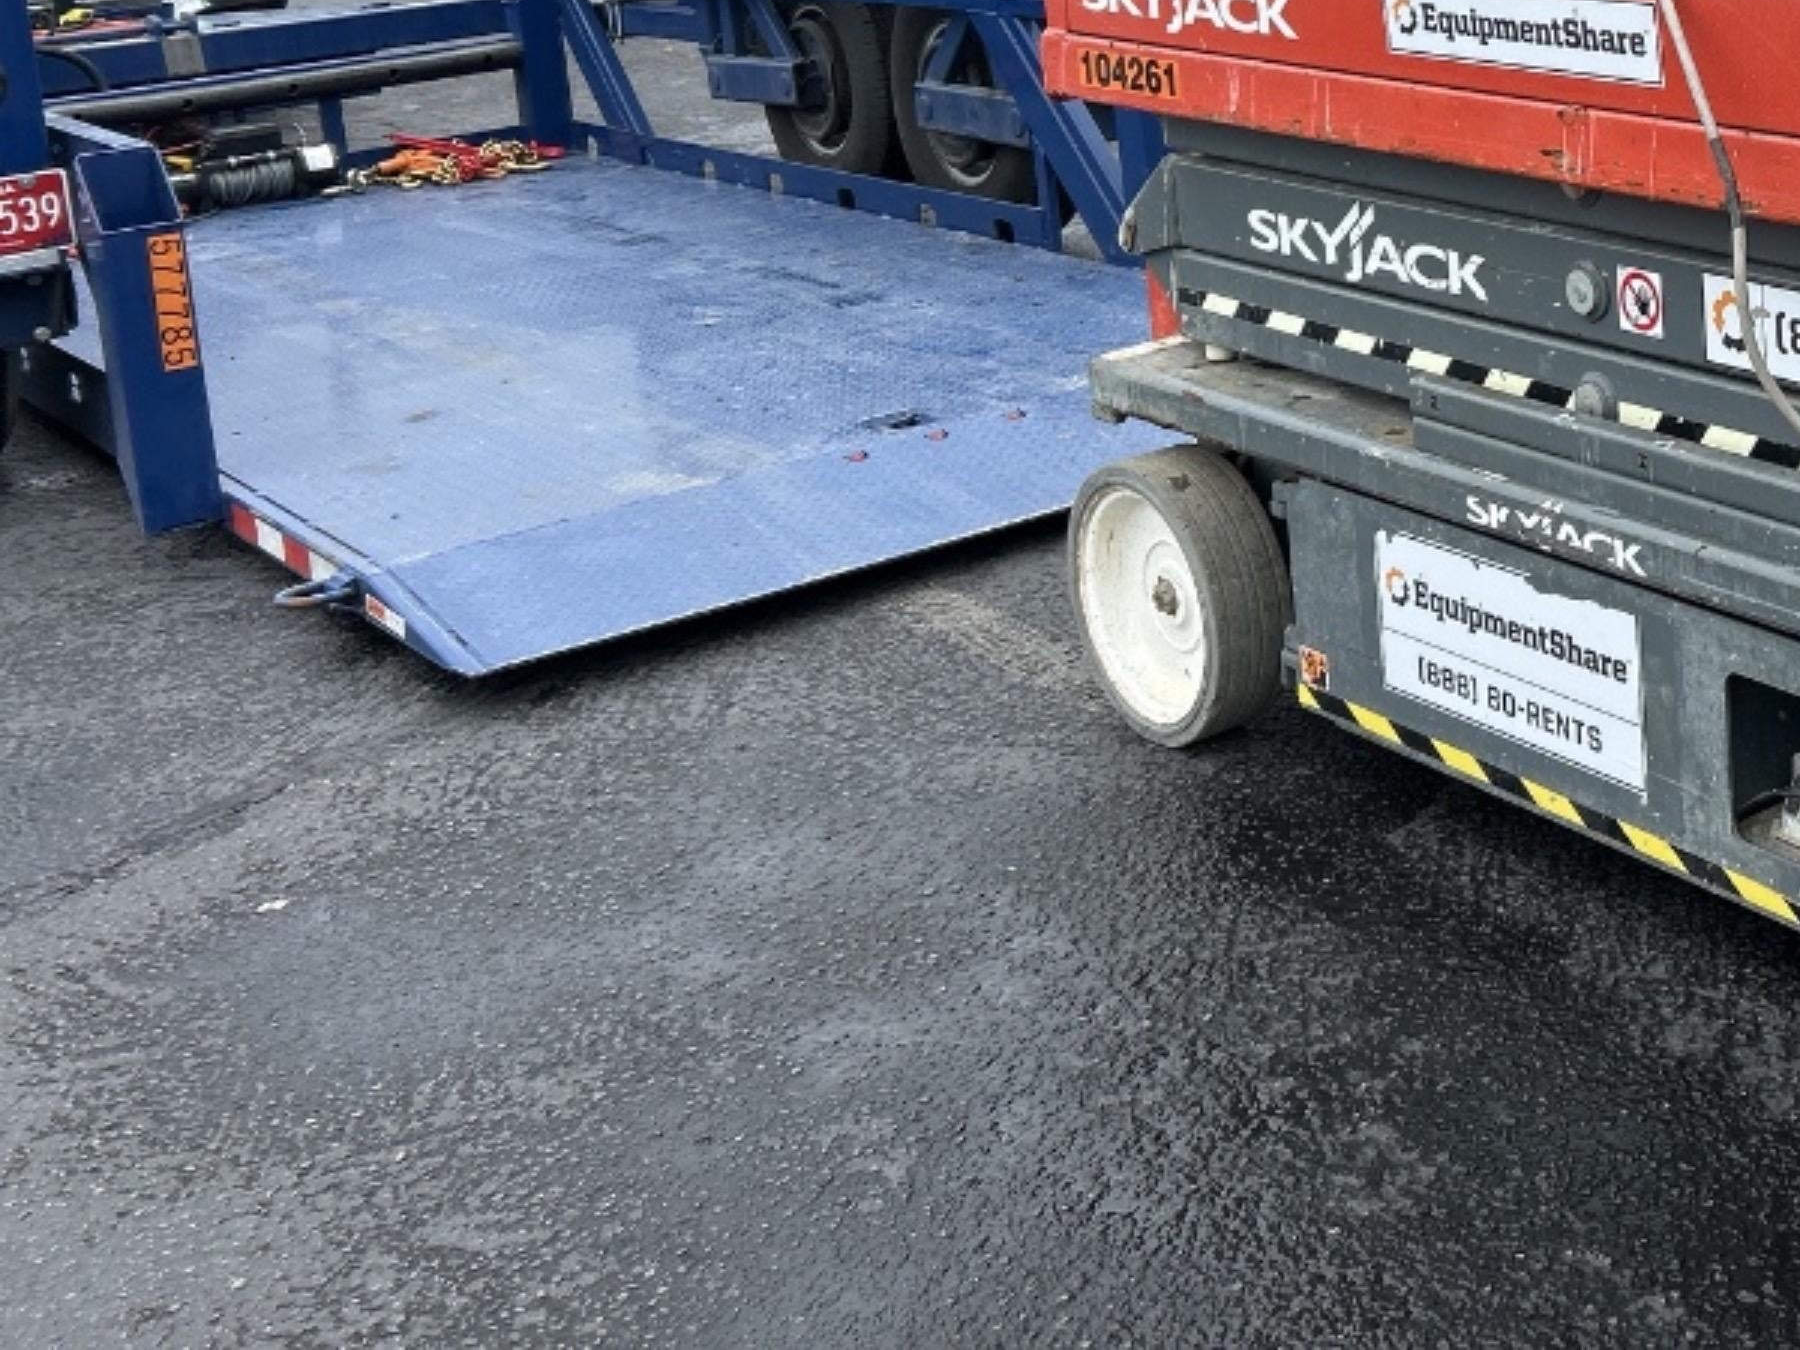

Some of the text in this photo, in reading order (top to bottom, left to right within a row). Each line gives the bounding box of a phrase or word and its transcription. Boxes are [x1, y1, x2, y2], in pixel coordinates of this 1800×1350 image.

[1081, 50, 1177, 97] 104261
[1421, 2, 1648, 57] EquipmentShare
[1247, 200, 1489, 303] SKYJACK
[150, 239, 196, 366] 577785
[1412, 579, 1629, 684] EquipmentShare
[1418, 656, 1604, 753] (888) 80-RENTS
